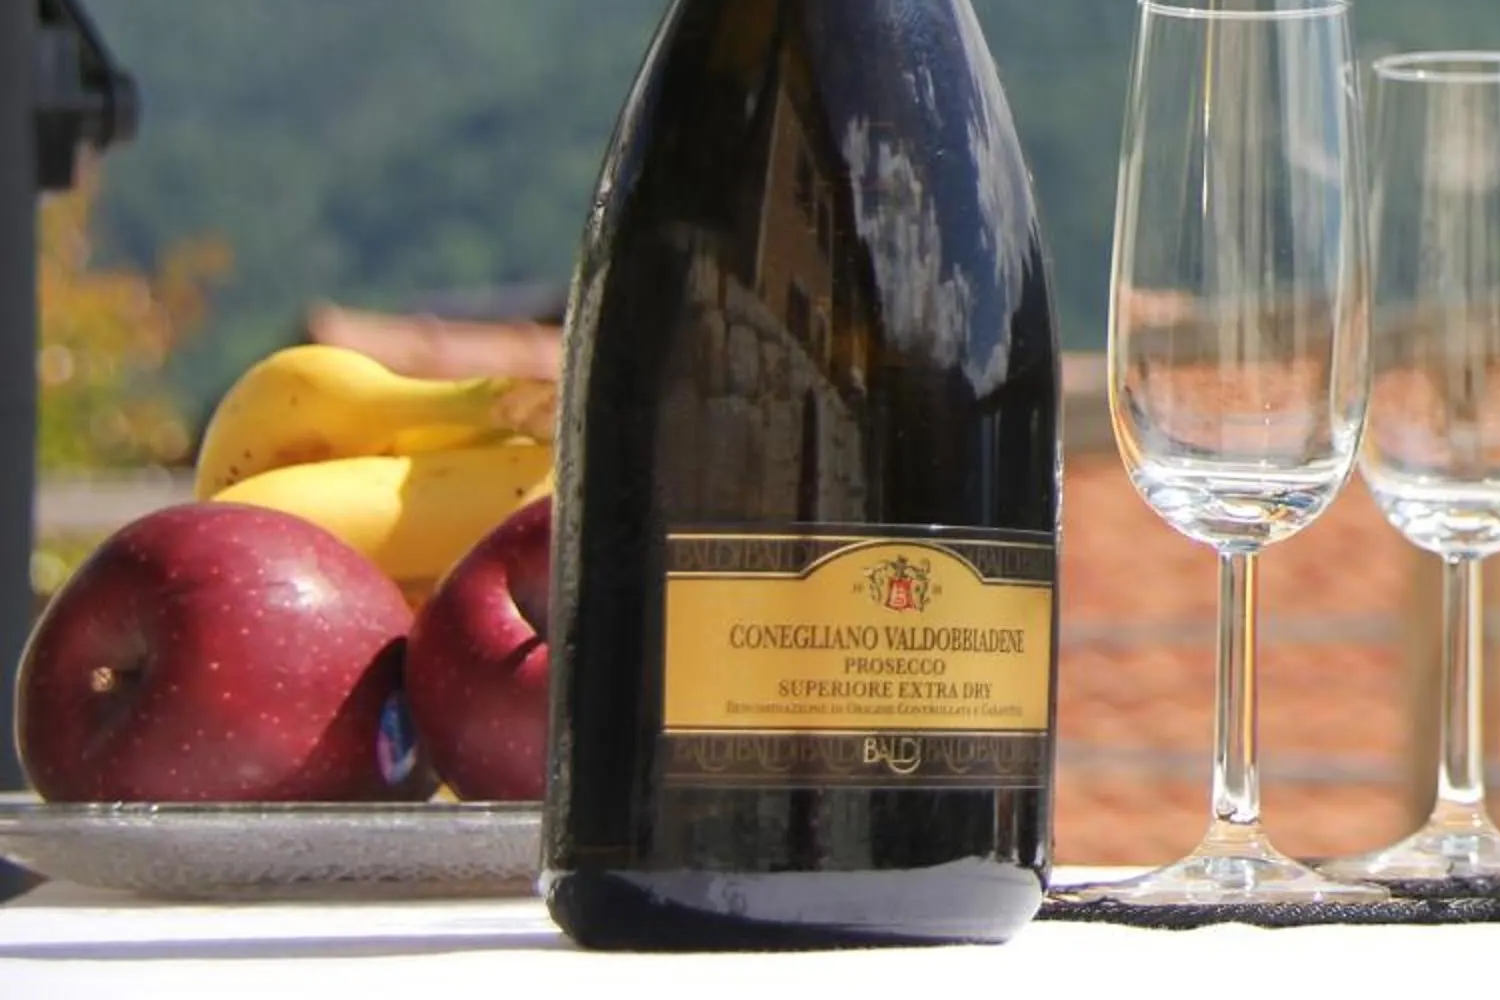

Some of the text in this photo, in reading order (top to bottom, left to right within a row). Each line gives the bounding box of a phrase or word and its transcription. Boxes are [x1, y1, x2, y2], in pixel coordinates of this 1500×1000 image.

[729, 623, 1025, 653] CONEGLIANO VALDOBBIADENE
[844, 656, 946, 676] PROSECCO
[778, 679, 993, 699] SUPERIORE EXTRA DRY
[863, 737, 921, 774] BALDI
